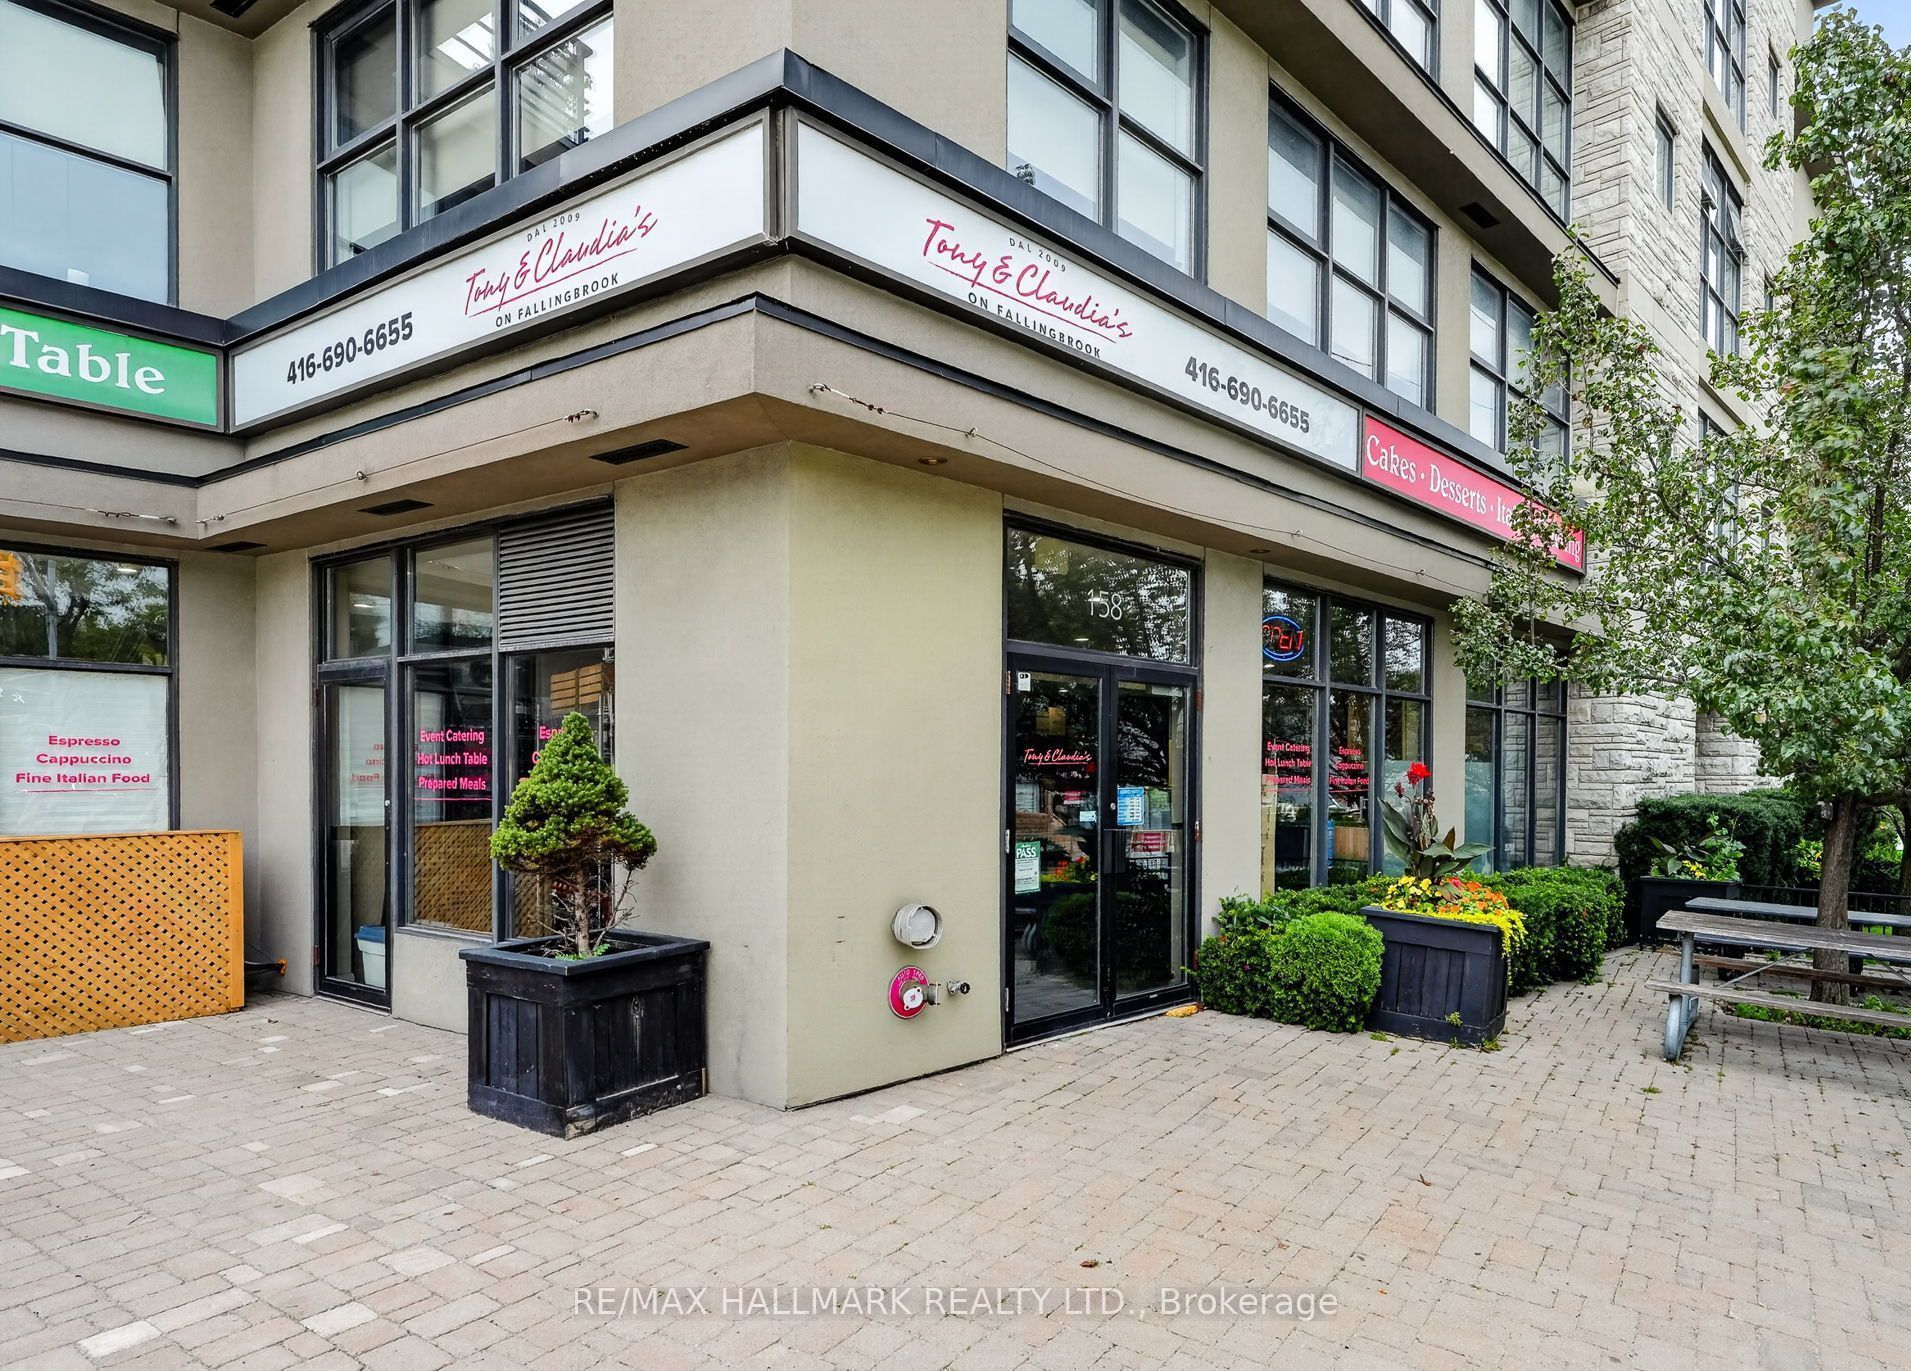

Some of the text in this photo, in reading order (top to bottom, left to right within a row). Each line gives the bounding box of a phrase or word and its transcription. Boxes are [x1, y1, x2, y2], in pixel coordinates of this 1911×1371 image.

[526, 212, 581, 243] DAL 2009
[464, 205, 659, 316] Tony & Claudia's
[1008, 237, 1067, 273] DAL 2009
[922, 218, 1134, 339] Tony & Claudia's
[494, 272, 619, 328] ON FALLINGBROOK
[967, 291, 1102, 359] ON FALLINGBROOK
[0, 324, 166, 395] Table
[286, 311, 413, 385] 416-690-6655
[1184, 355, 1310, 434] 416-690-6655
[1365, 434, 1417, 484] Cakes
[1429, 464, 1488, 515] Desserts
[1087, 588, 1123, 620] 158
[48, 735, 121, 748] Espresso
[420, 728, 485, 745] Event Catering
[35, 753, 132, 766] Cappuccino
[417, 752, 488, 765] Hot Lunch Table
[15, 773, 151, 783] Fine Italian Food
[418, 776, 487, 792] Prepared Meals
[1016, 847, 1037, 859] PASS
